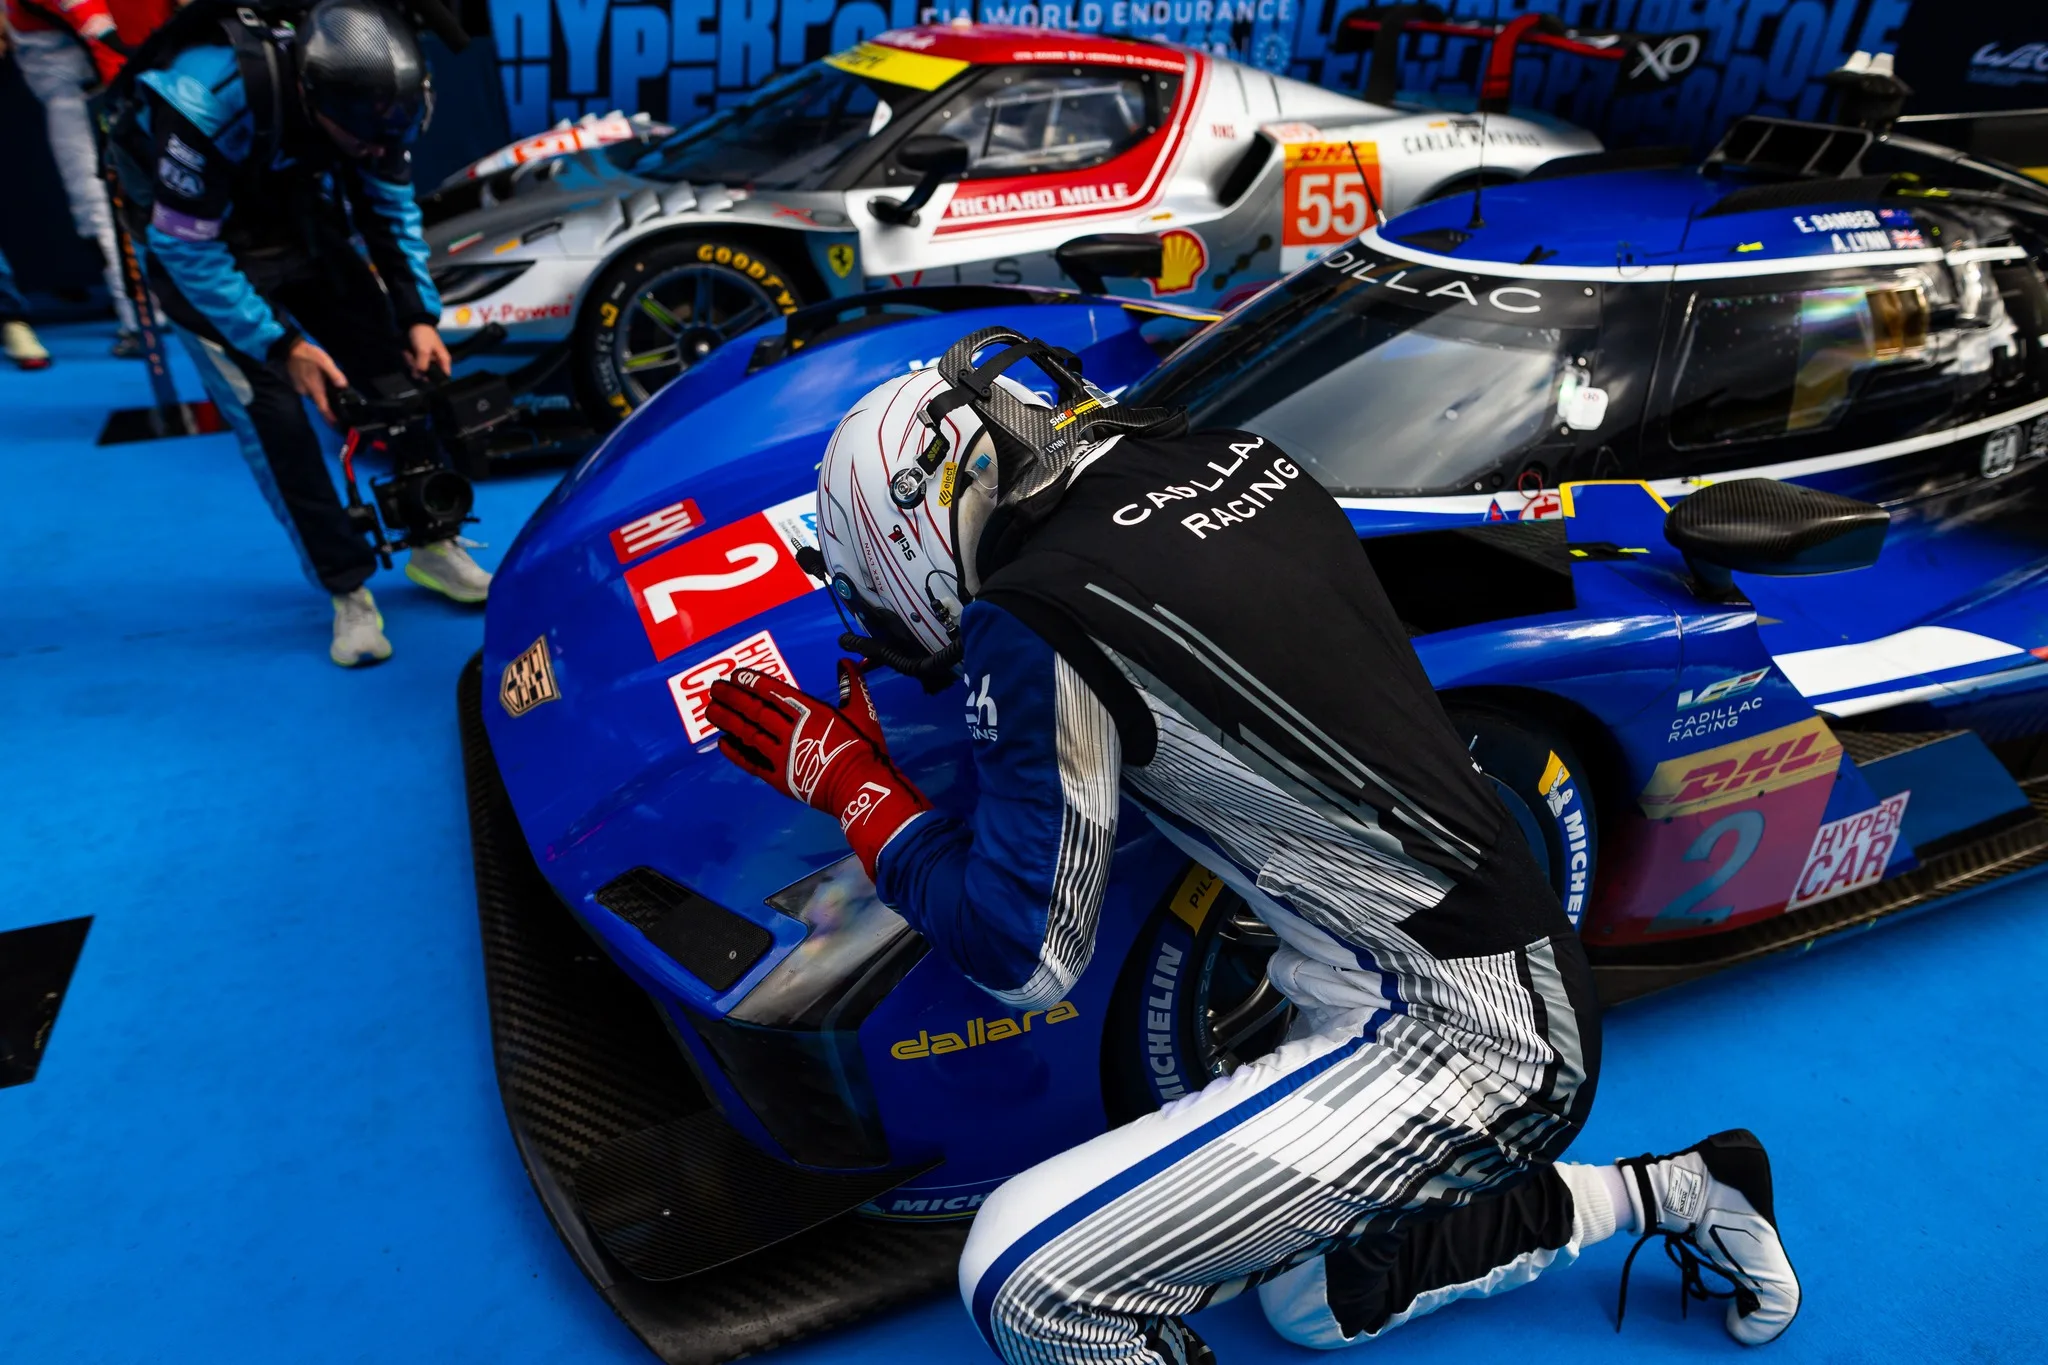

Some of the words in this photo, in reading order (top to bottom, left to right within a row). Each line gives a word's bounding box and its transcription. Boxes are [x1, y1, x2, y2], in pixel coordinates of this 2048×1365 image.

[986, 3, 1100, 30] WORLD
[1112, 0, 1291, 27] ENDURANCE
[1629, 34, 1700, 82] XO
[951, 188, 1057, 218] RICHARD
[1061, 182, 1129, 206] MILLE
[1296, 172, 1369, 238] 55
[1845, 229, 1892, 253] LYNN
[1323, 249, 1542, 314] DILLAC
[477, 302, 572, 324] V-Power
[1045, 437, 1067, 454] LYNN
[944, 466, 954, 490] eject
[1180, 457, 1300, 540] RACING
[619, 502, 694, 556] HY
[864, 542, 876, 567] LYNN
[642, 541, 780, 625] 2
[872, 568, 885, 593] ALEX
[1667, 716, 1739, 744] RACING
[1671, 697, 1763, 730] CADILLAC
[1667, 731, 1821, 805] DHL
[1814, 798, 1904, 857] HYPER
[1645, 809, 1766, 933] 2
[1796, 834, 1894, 902] CAR
[890, 1000, 1081, 1061] dallara
